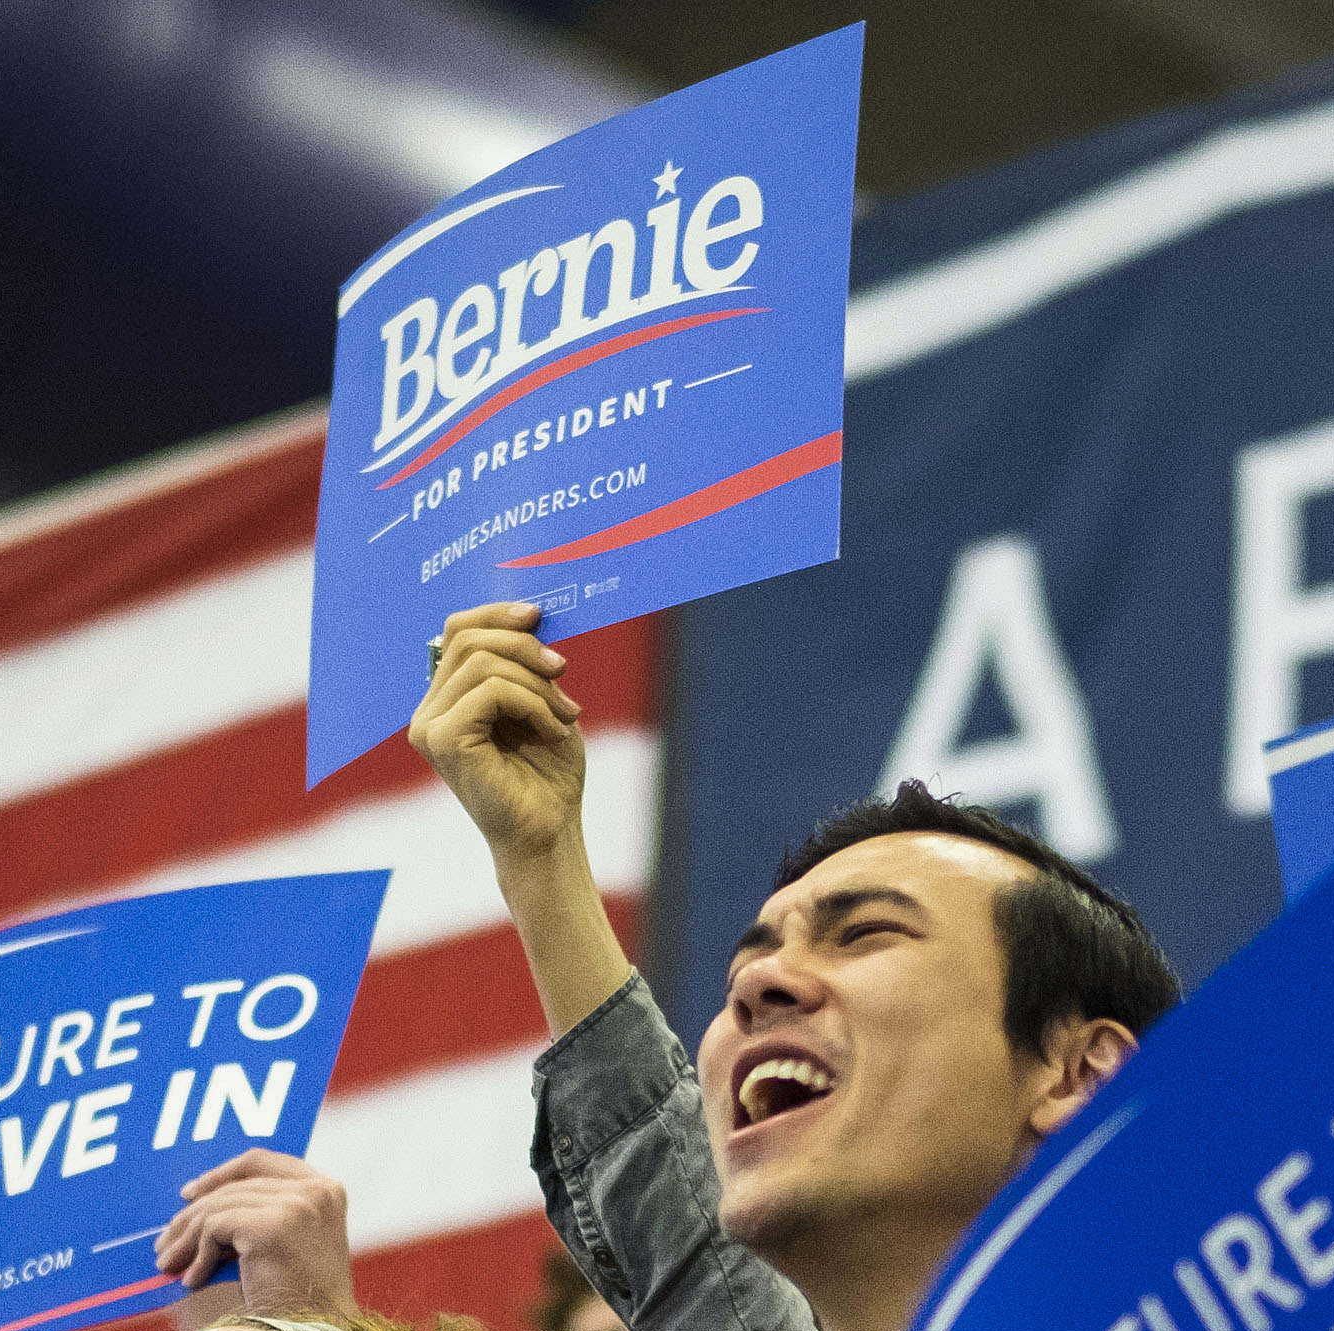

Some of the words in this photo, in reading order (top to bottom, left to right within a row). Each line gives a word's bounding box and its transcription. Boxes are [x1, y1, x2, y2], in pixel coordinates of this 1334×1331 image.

[373, 161, 764, 452] Bernie
[412, 468, 462, 521] FOR
[472, 379, 675, 473] PRESIDENT
[420, 462, 648, 585] BERNIESANDERS.COM
[881, 534, 1118, 864] A
[182, 973, 319, 1048] TO
[153, 1061, 296, 1150] IN
